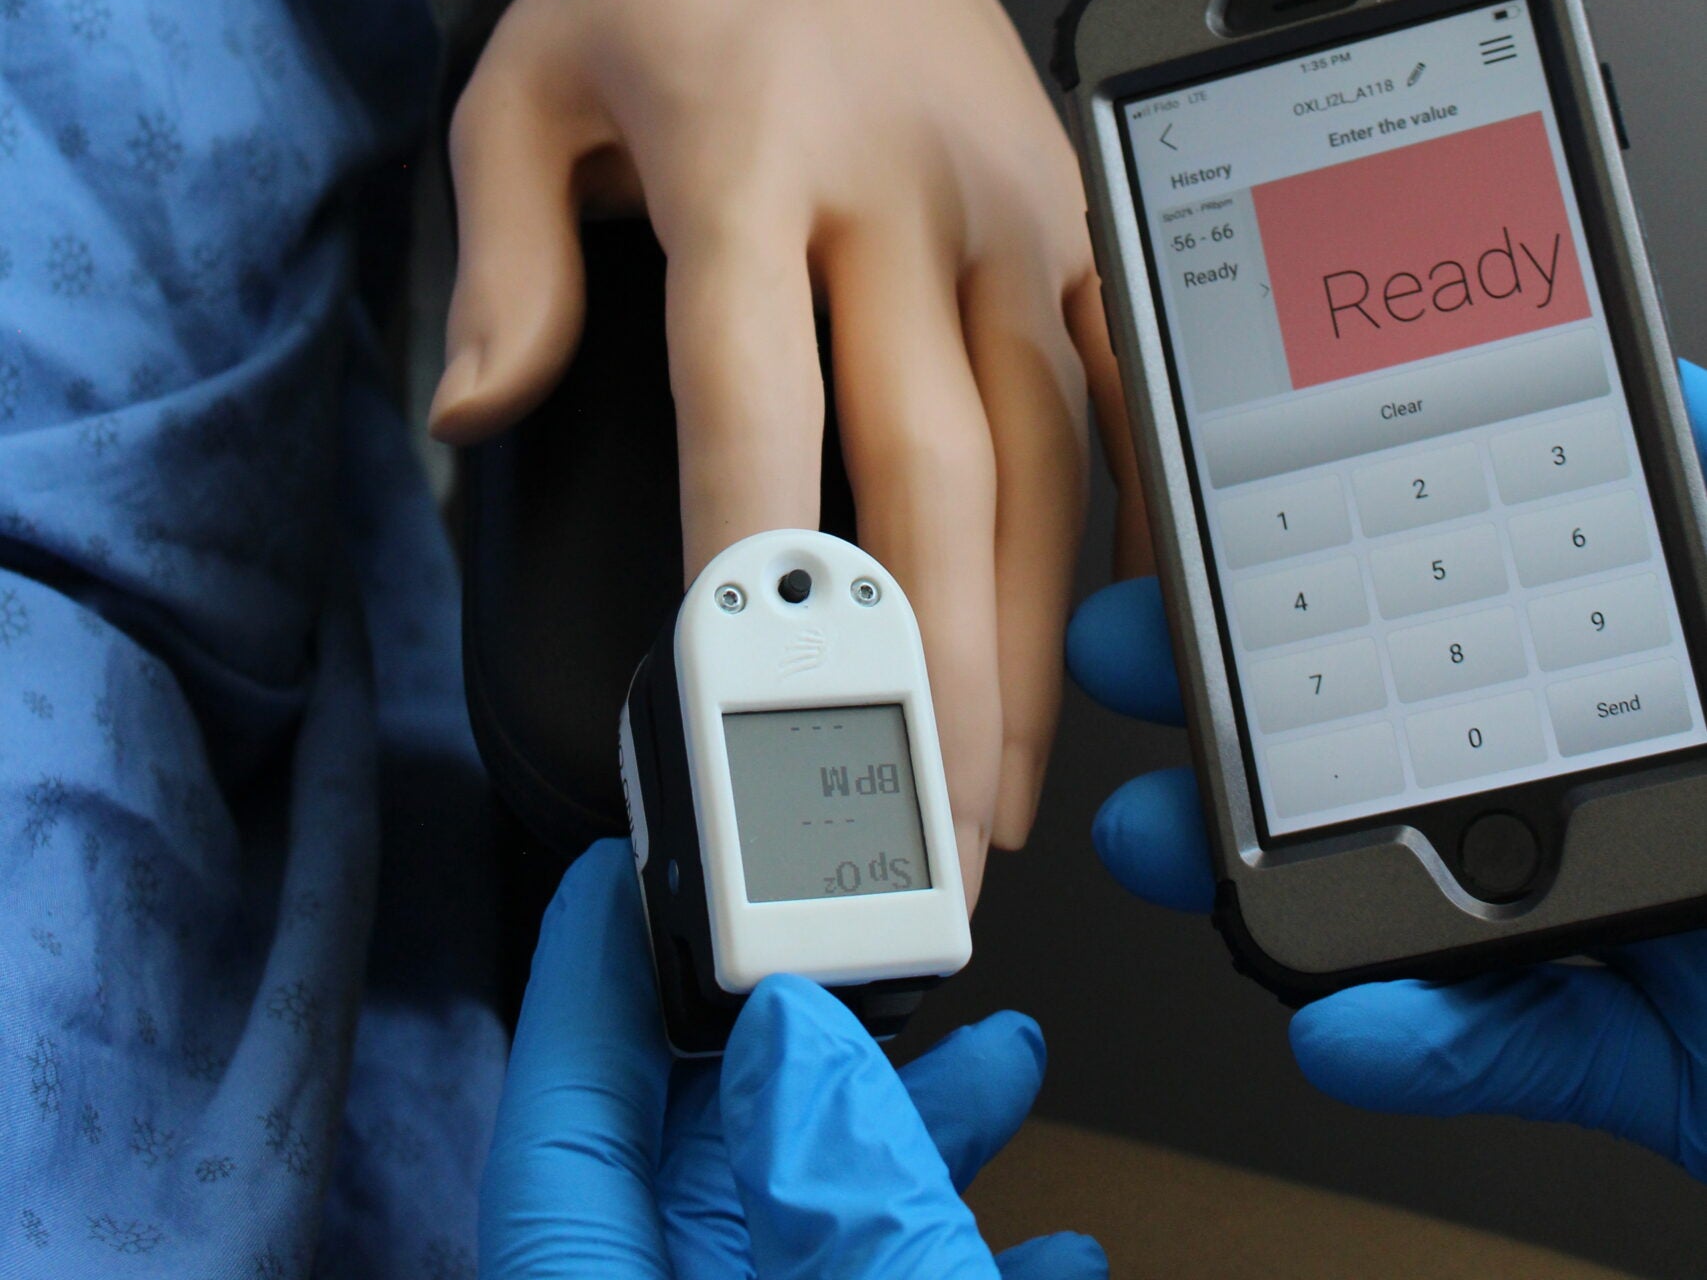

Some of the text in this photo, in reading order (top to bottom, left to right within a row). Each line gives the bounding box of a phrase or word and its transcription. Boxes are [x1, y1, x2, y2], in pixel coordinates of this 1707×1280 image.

[1299, 51, 1352, 74] 1:35 PM
[1152, 90, 1209, 114] Fido LTE
[1328, 103, 1459, 149] Enter the value
[1170, 163, 1233, 191] History
[1211, 224, 1235, 243] 66
[1183, 261, 1239, 289] Ready
[1323, 226, 1561, 339] Ready
[1380, 398, 1424, 420] Clear
[1551, 446, 1567, 466] 3
[1412, 479, 1429, 500] 2
[1277, 512, 1288, 531] 1
[1571, 528, 1587, 549] 6
[1431, 560, 1447, 581] 5
[1293, 592, 1309, 613] 4
[1590, 611, 1606, 632] 9
[1449, 644, 1465, 664] 8
[1309, 674, 1323, 696] 7
[1596, 695, 1641, 719] Send
[1468, 727, 1484, 749] 0
[820, 763, 900, 797] BPM
